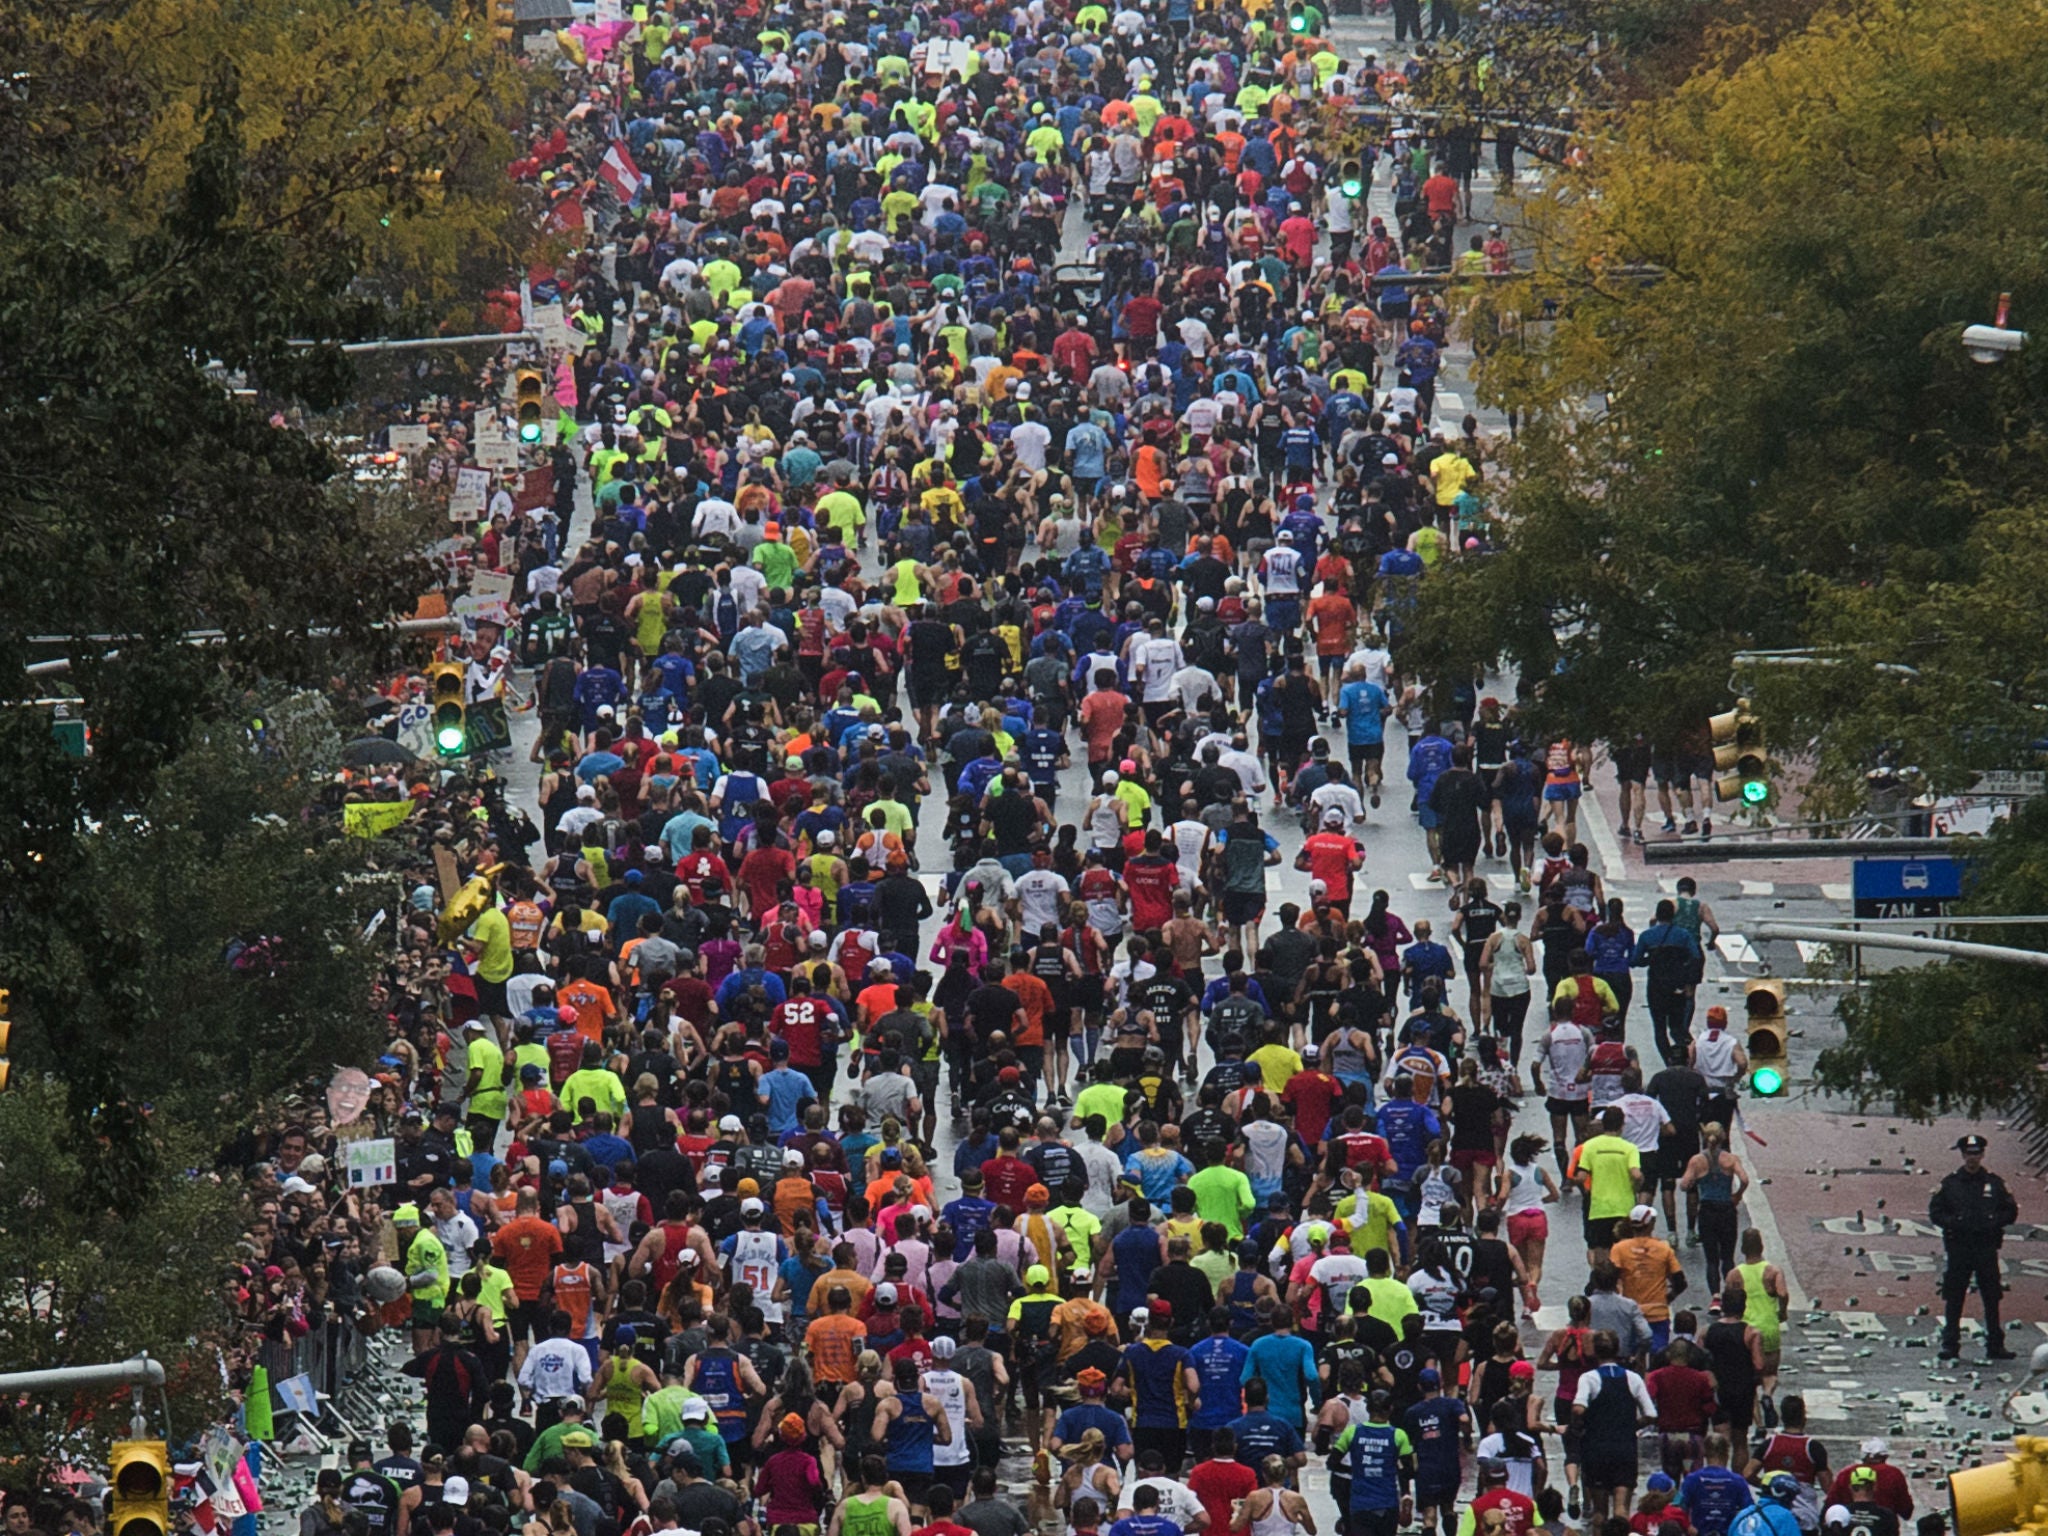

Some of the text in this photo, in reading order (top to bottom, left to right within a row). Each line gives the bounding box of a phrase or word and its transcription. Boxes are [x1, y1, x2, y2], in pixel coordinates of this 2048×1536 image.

[1875, 903, 1916, 918] 7AM
[1146, 984, 1177, 996] MEXICO
[1155, 996, 1165, 1004] IS
[784, 1001, 815, 1024] 52
[743, 1265, 769, 1291] 51
[382, 1465, 415, 1480] FRANCE
